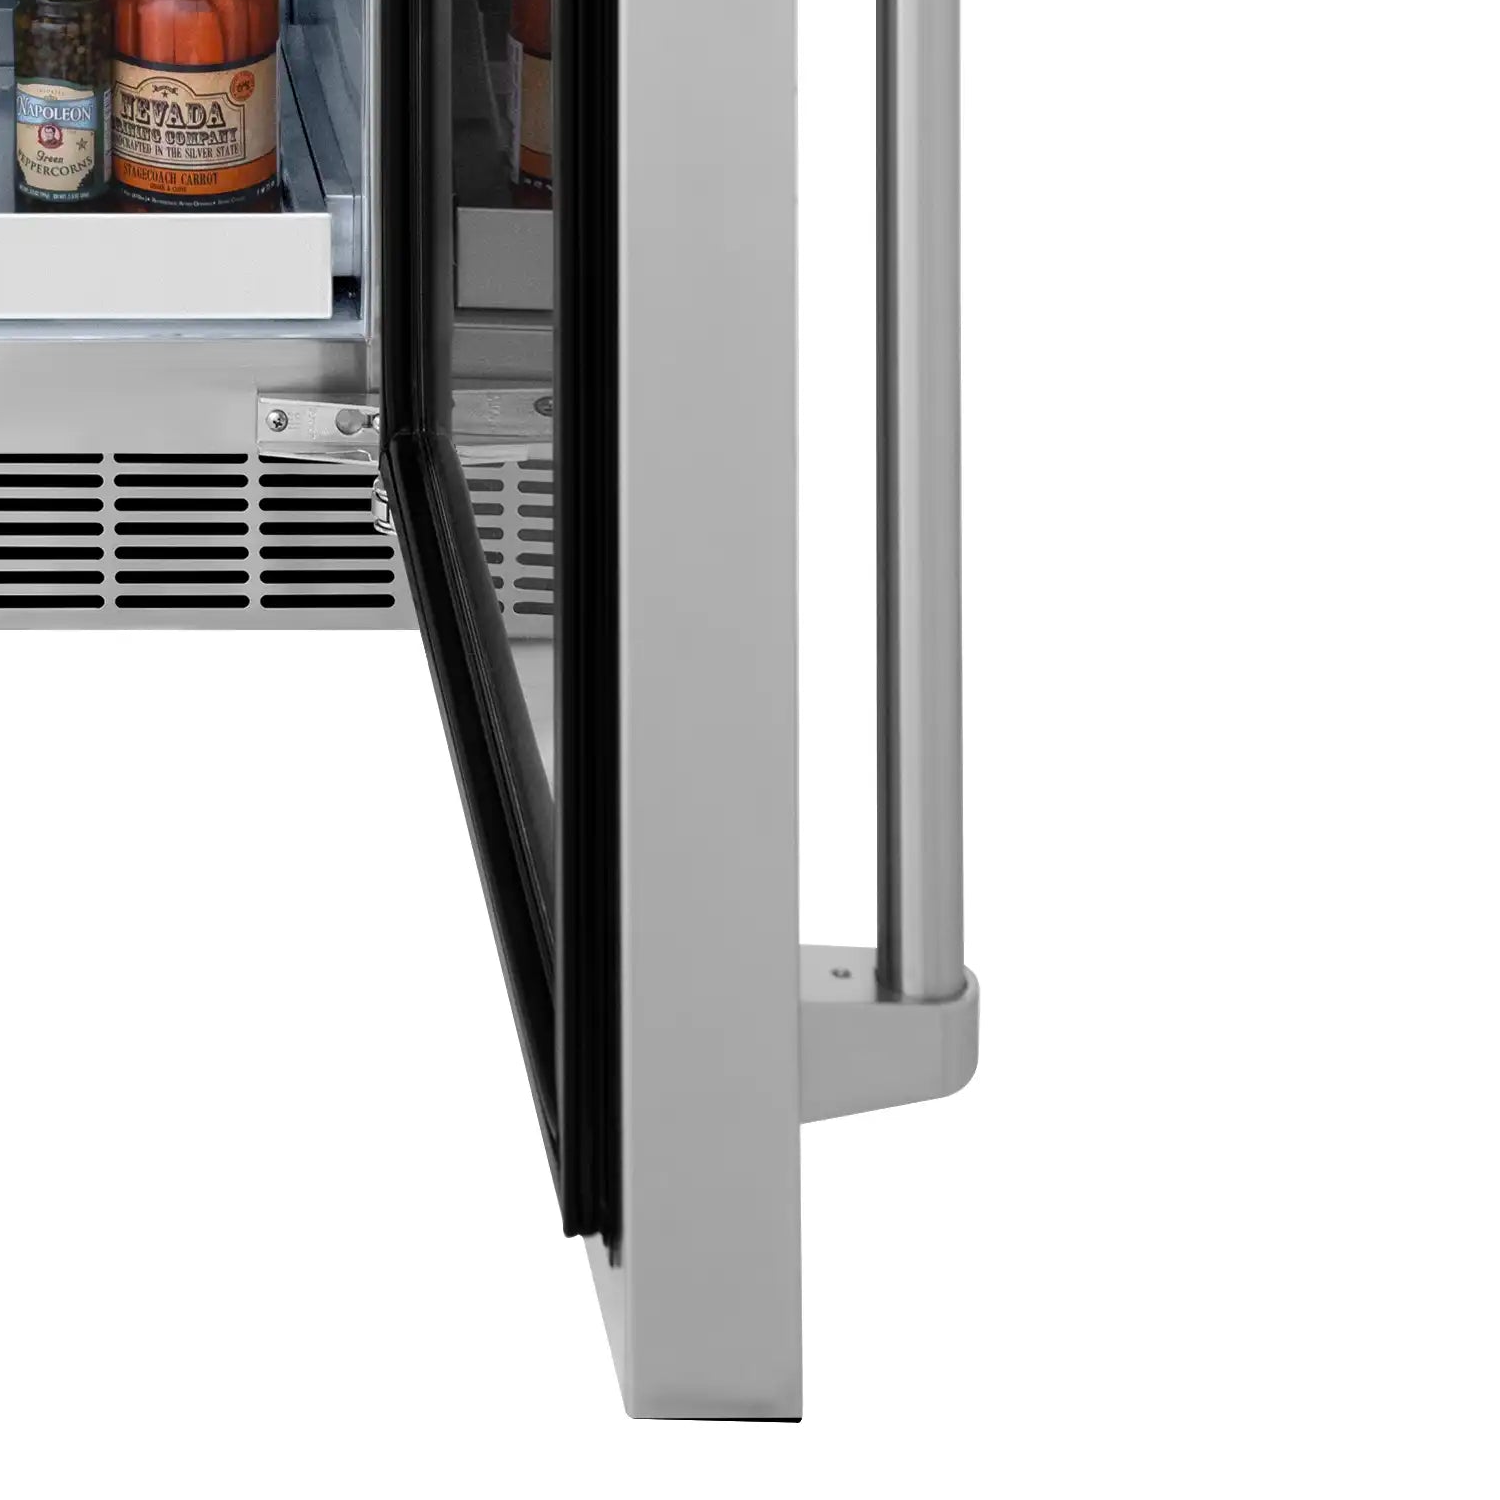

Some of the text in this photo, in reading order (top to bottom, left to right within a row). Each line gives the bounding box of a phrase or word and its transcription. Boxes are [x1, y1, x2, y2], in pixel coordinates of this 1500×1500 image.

[17, 95, 92, 122] NAPOLEON
[119, 91, 227, 130] NEVADA
[164, 127, 238, 147] COMPANY
[36, 150, 64, 164] Green
[155, 143, 163, 156] IN
[166, 145, 182, 159] THE
[184, 146, 213, 160] SILVER
[215, 145, 239, 159] STATE
[123, 162, 219, 186] STAGECOACH CARROT
